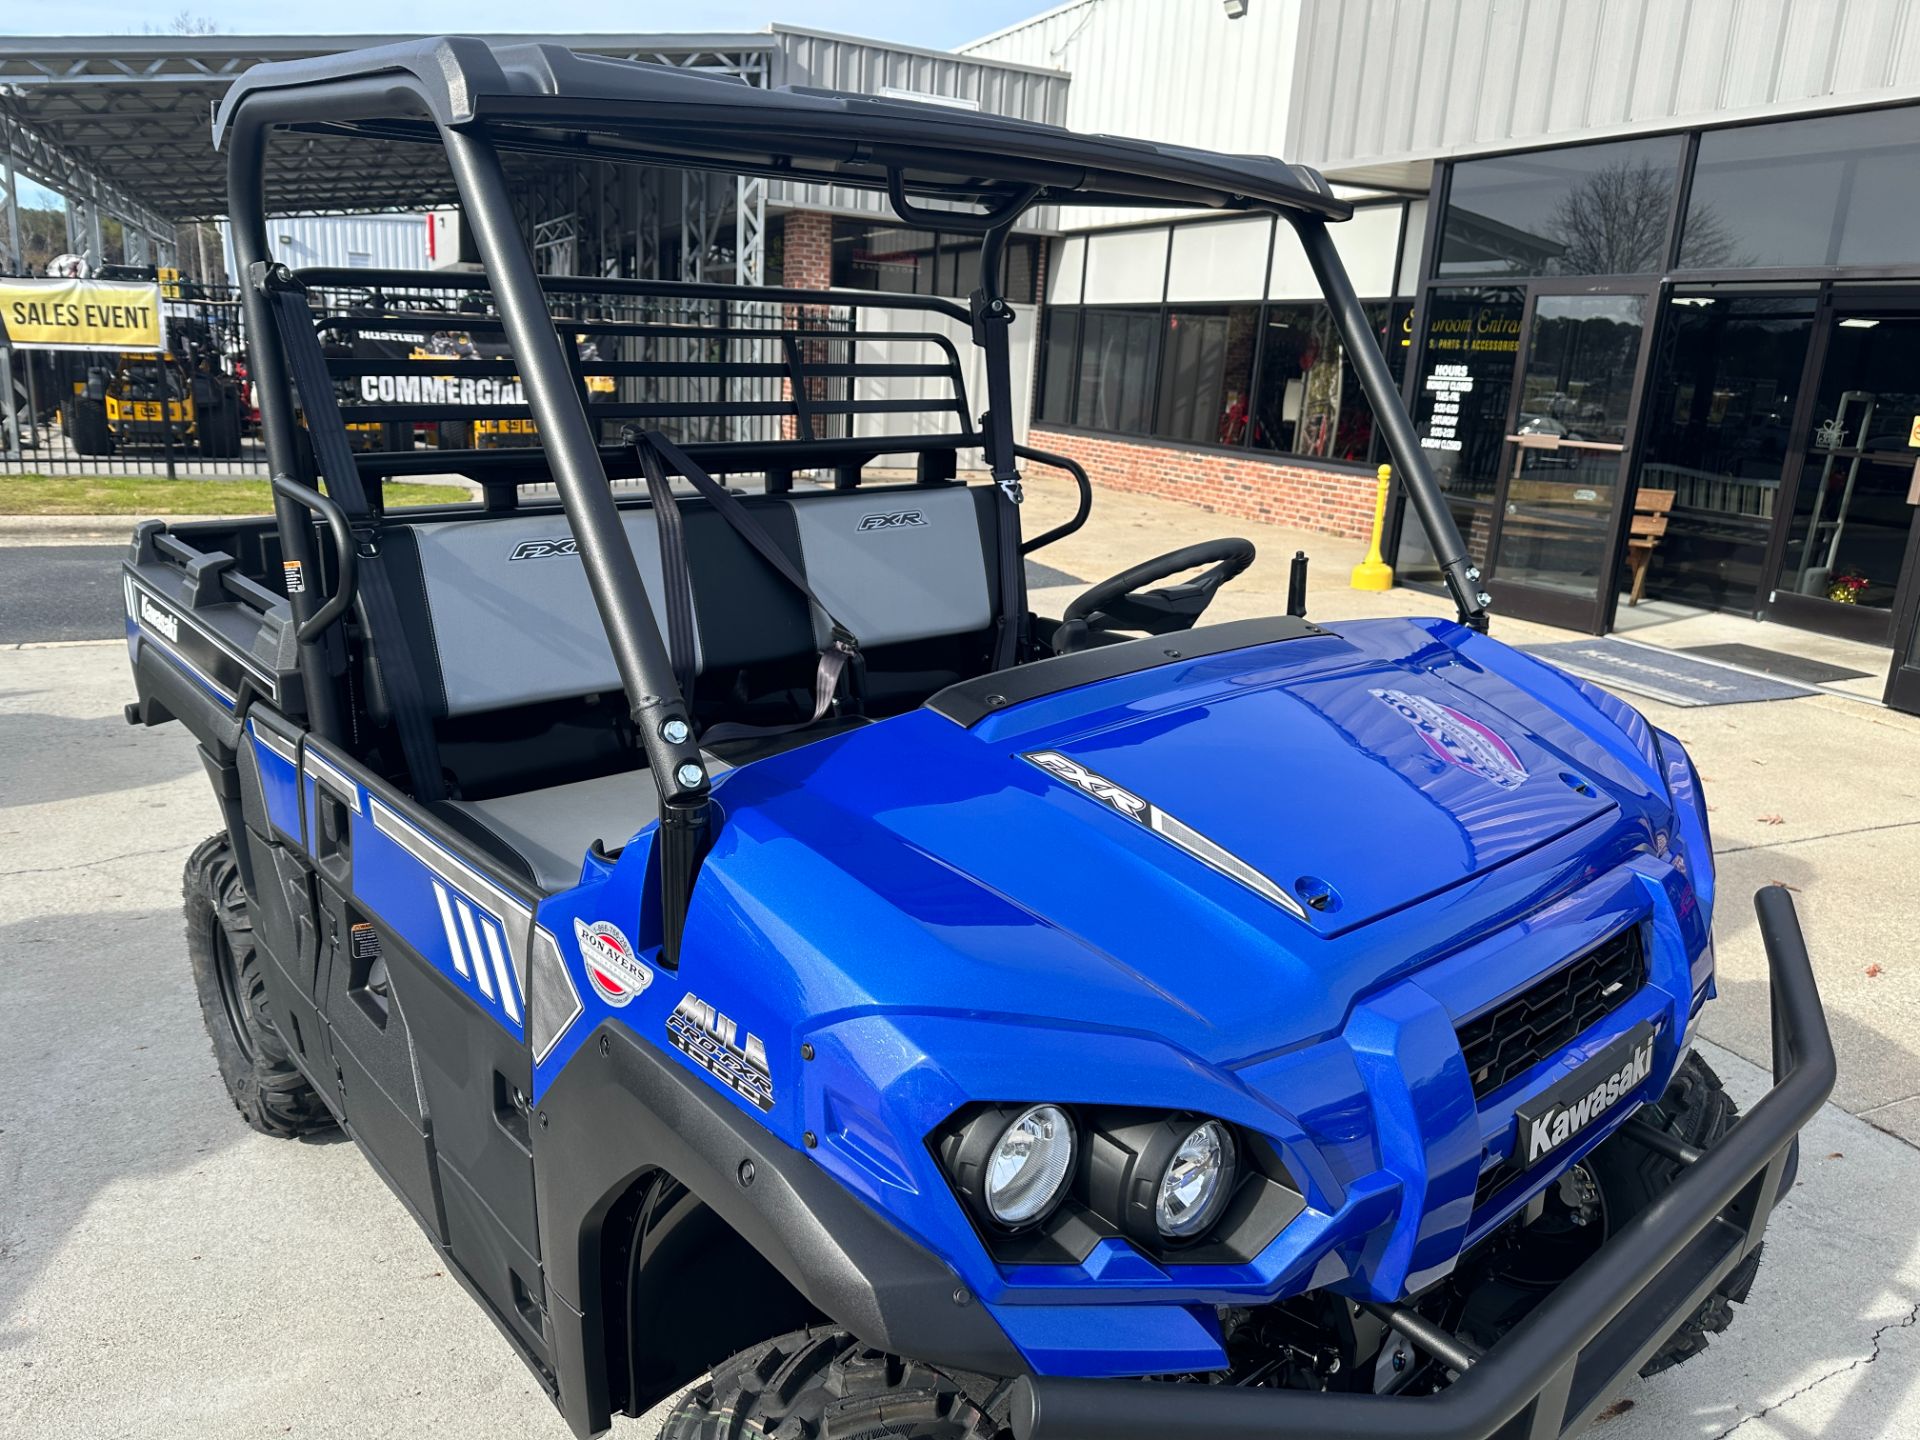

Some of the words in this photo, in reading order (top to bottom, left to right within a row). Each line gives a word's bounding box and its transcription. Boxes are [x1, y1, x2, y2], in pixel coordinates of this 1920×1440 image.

[13, 301, 79, 327] SALES
[85, 304, 150, 328] EVENT
[358, 330, 425, 343] HUSTLER
[1438, 339, 1461, 350] PARTS
[1471, 339, 1520, 351] ACCESSORIES
[361, 375, 529, 405] COMMERCIAL
[1434, 364, 1468, 377] HOURS
[856, 511, 929, 532] FXR
[141, 593, 178, 643] Kawasaki
[1028, 752, 1148, 823] FXR
[581, 928, 605, 953] RON
[605, 946, 646, 982] AYERS
[667, 1014, 774, 1098] PRO-FXR
[673, 992, 771, 1082] MULE
[677, 1035, 762, 1106] 1000
[1528, 1036, 1655, 1163] Kawasaki
